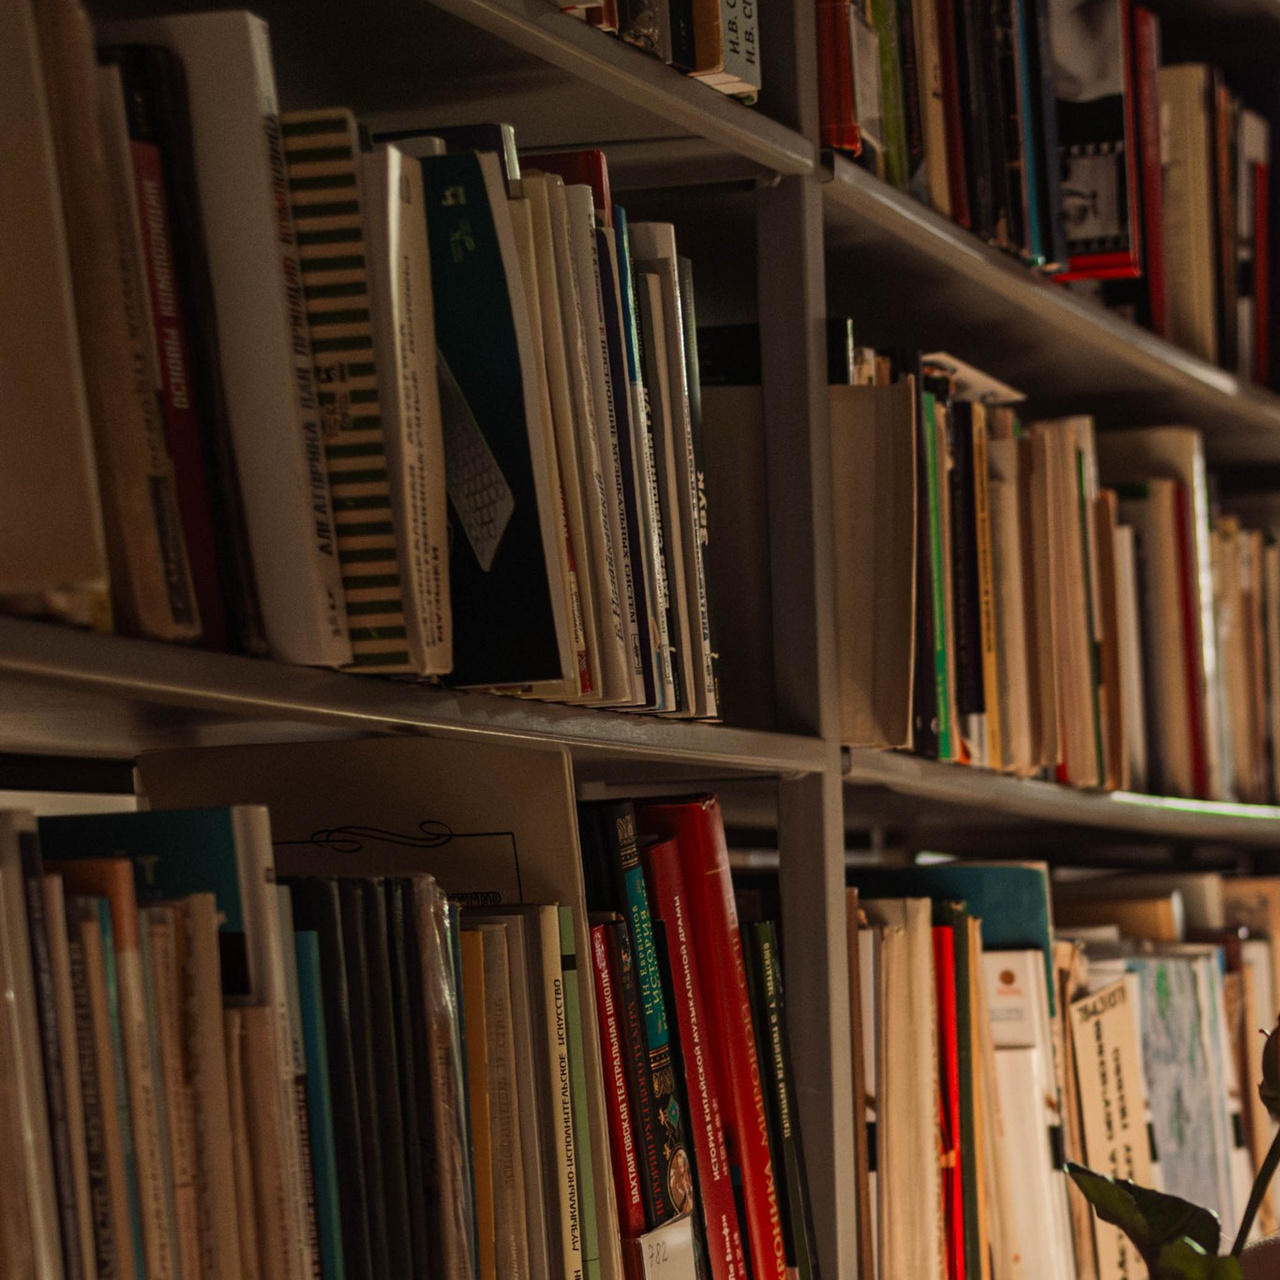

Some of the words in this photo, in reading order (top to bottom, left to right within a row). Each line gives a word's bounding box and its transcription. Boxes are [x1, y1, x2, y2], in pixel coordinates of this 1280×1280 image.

[141, 175, 178, 319] КОМПОЗИЦИИ
[281, 252, 307, 356] ПРИНЦИП
[161, 323, 190, 410] ОСНОВЫ
[294, 364, 313, 411] КАК
[599, 338, 619, 448] ПОСТРОЕНИЕ
[303, 418, 333, 557] АЛЕАТОРИКА
[610, 441, 629, 558] МУЗЫКАЛЬНЫХ
[622, 563, 636, 625] СИСТЕМ
[629, 902, 649, 976] ЕВРЕИНОВ
[636, 907, 662, 1004] ИСТОРИЯ
[673, 893, 688, 943] ДРАМЫ
[551, 978, 566, 1047] ИСКУССТВО
[599, 967, 614, 1015] ШКОЛА
[640, 975, 652, 995] Н.
[643, 994, 655, 1015] Н.
[679, 944, 701, 1044] МУЗЫКАЛЬНОЙ
[606, 1016, 627, 1101] ТЕАТРАЛЬНАЯ
[693, 1045, 713, 1123] КИТАЙСКОЙ
[740, 1002, 770, 1147] МИРОВОЙ
[557, 1053, 581, 1253] МУЗЫКАЛЬНО-ИСПОЛНИТЕЛЬСКОЕ
[617, 1102, 641, 1204] ВАХТАНГОВСКАЯ
[705, 1123, 722, 1181] ИСТОРИЯ
[647, 1241, 669, 1268] 782
